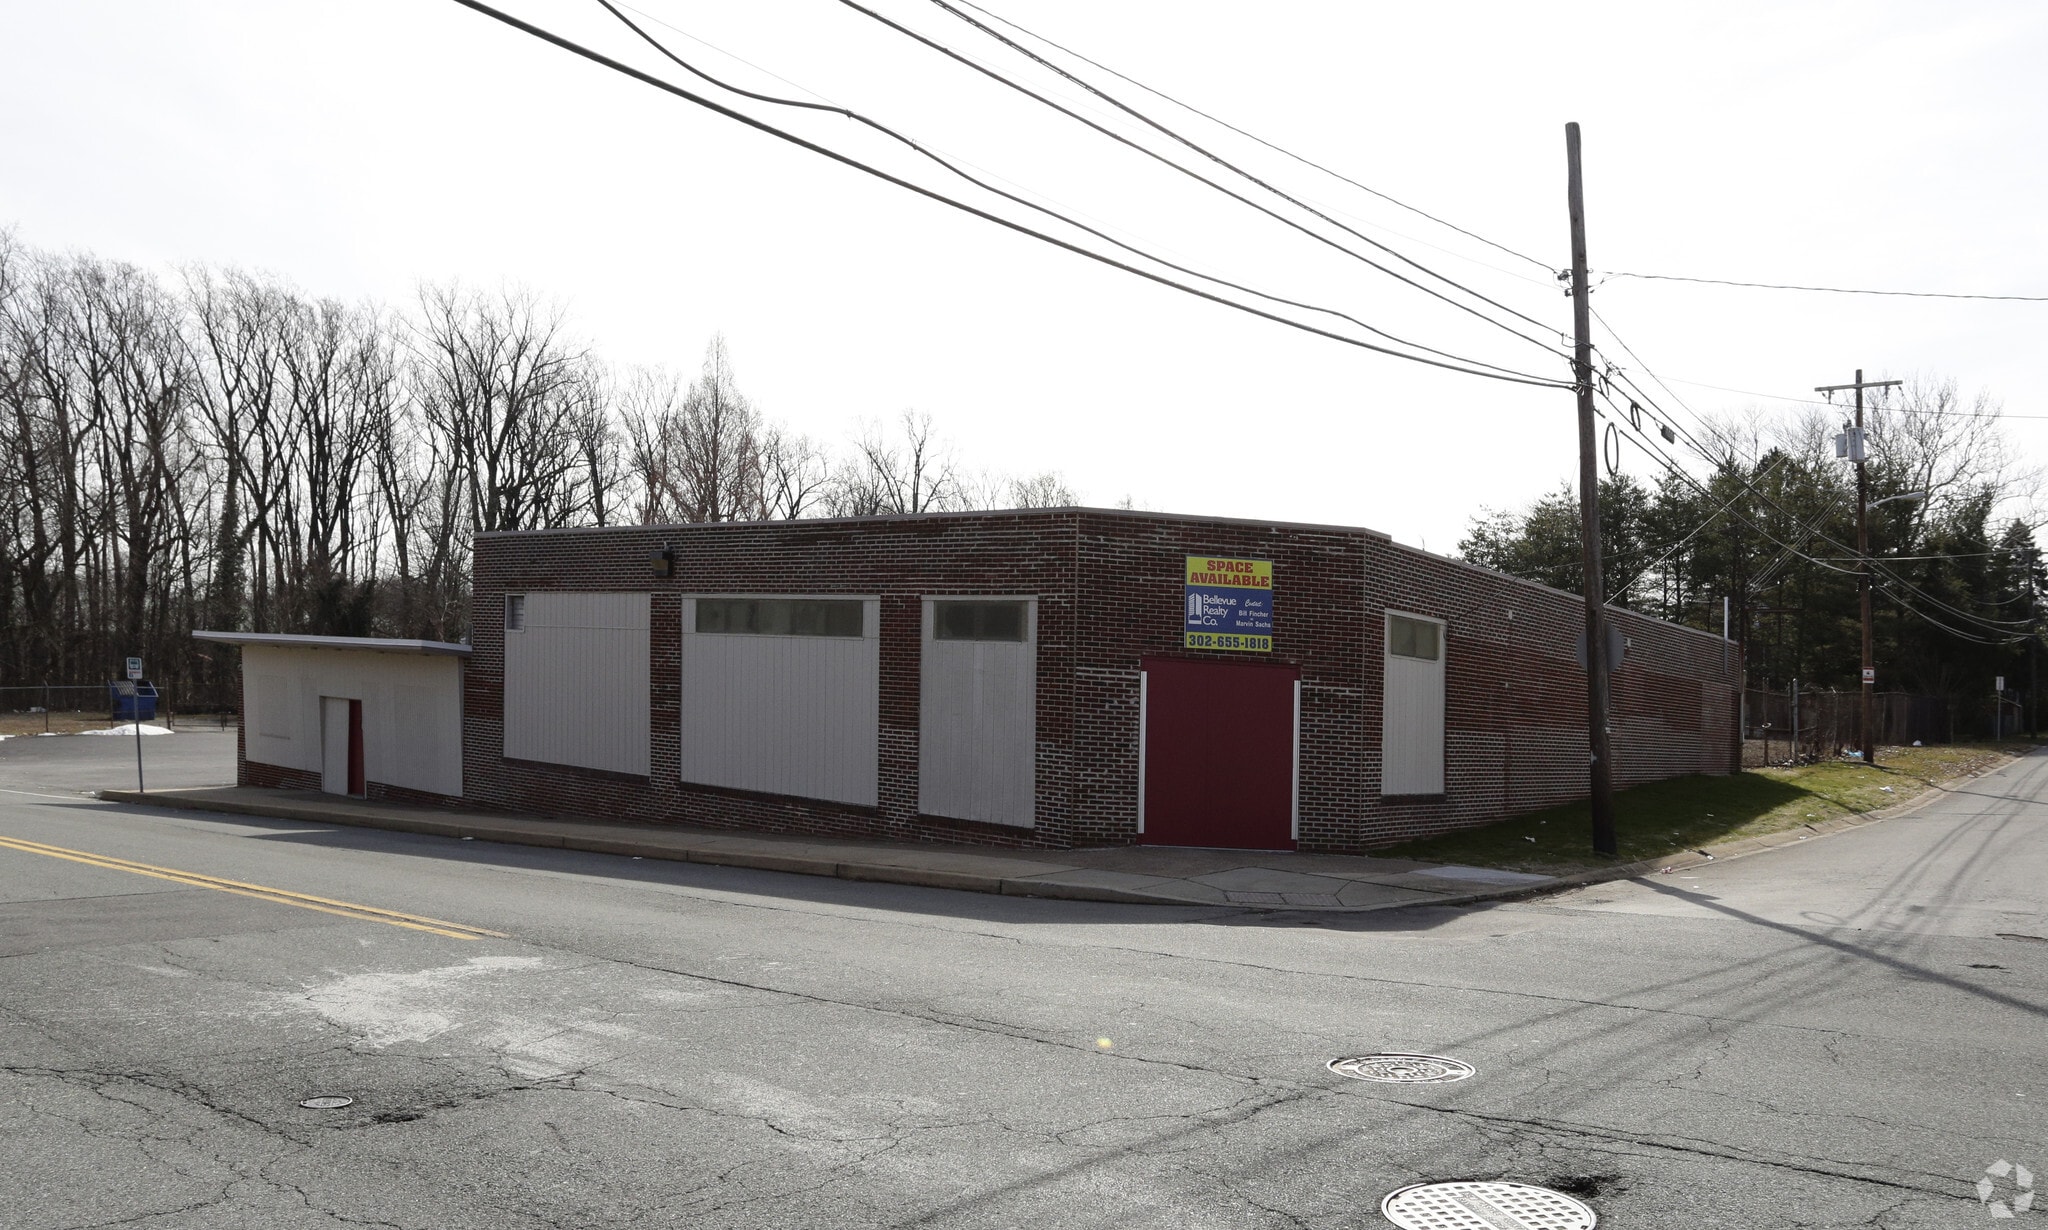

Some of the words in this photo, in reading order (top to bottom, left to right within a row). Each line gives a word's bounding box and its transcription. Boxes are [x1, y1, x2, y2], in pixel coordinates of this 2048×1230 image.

[1207, 560, 1253, 573] SPACE
[1190, 572, 1269, 587] AVAILABLE
[1203, 594, 1236, 605] Bellevue
[1203, 605, 1228, 618] Realty
[1203, 616, 1218, 626] Co.
[1189, 635, 1268, 649] 302-655-1818
